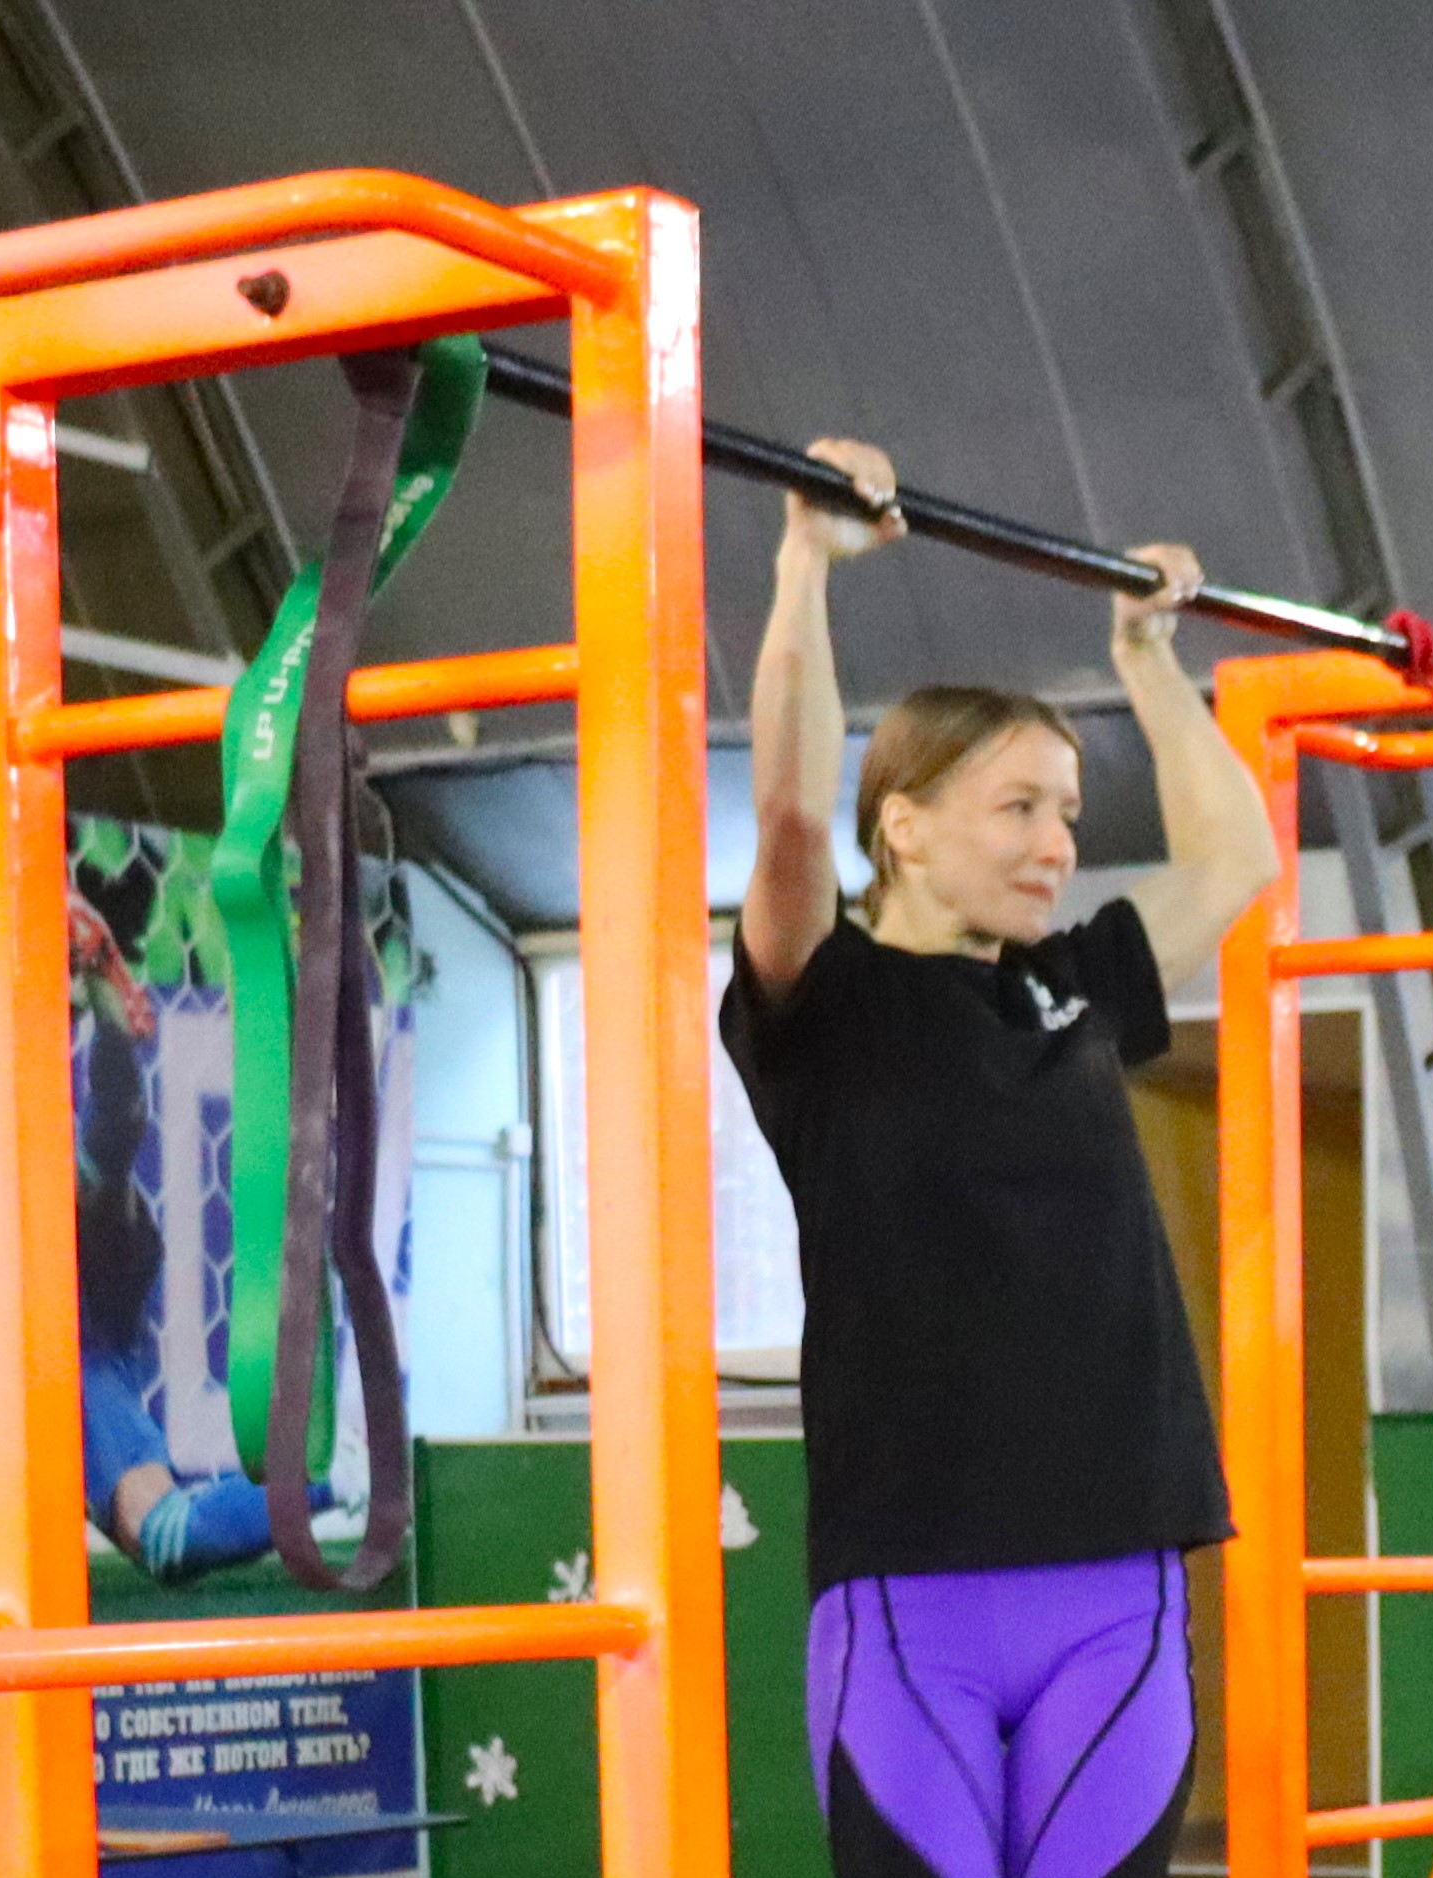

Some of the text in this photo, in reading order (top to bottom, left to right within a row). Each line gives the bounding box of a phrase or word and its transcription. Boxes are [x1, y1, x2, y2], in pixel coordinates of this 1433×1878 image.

[119, 1700, 281, 1740] СОБСТВЕННОМ
[114, 1750, 161, 1784] ГДЕ
[169, 1745, 206, 1778] ЖЕ
[214, 1738, 288, 1774] ПОТОМ
[295, 1732, 371, 1767] ЖИТЬ?
